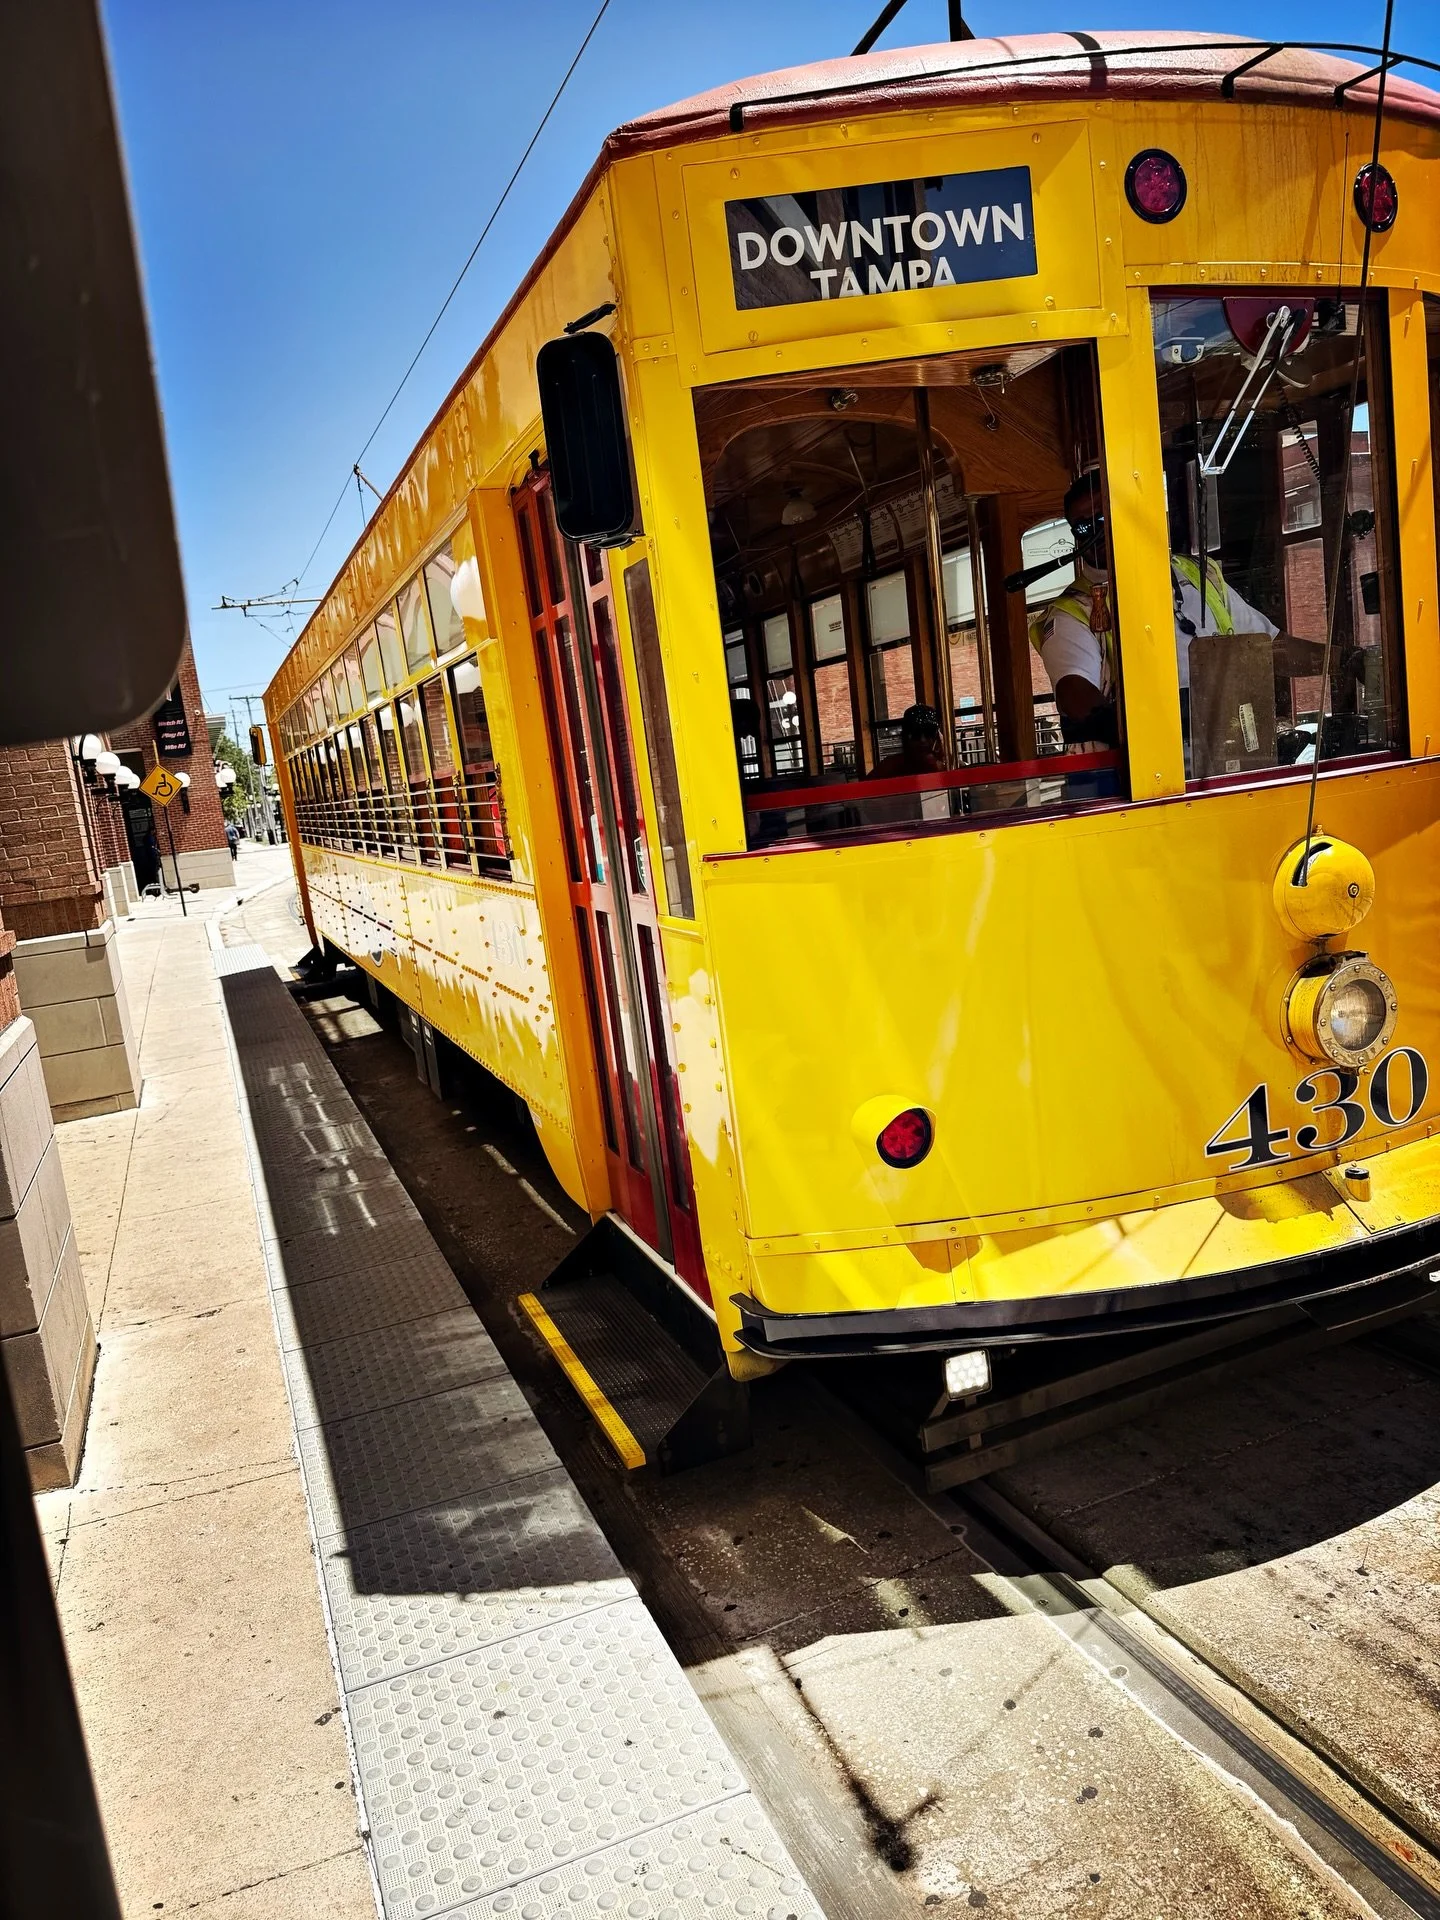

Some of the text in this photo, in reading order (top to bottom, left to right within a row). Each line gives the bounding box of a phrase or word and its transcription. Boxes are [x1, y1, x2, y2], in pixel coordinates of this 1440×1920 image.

[737, 202, 1025, 271] DOWNTOWN
[810, 256, 957, 300] TAMPA
[1203, 1046, 1429, 1173] 430
